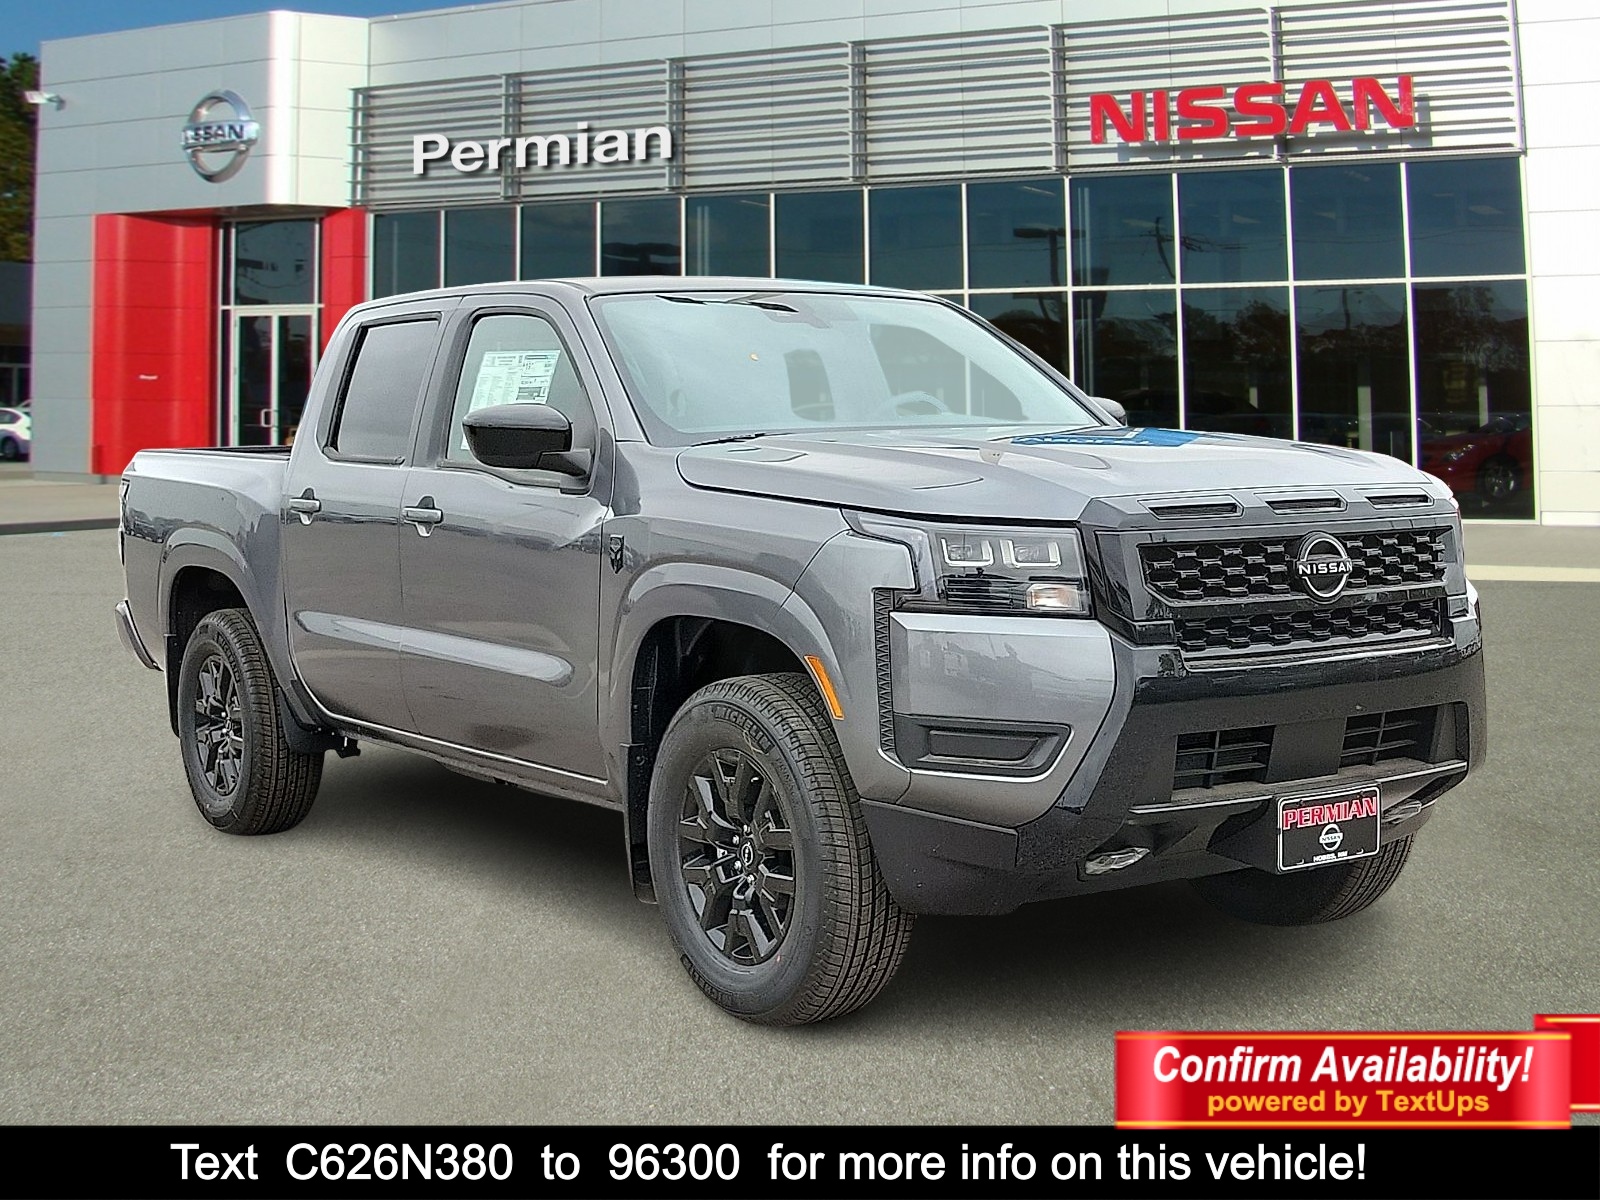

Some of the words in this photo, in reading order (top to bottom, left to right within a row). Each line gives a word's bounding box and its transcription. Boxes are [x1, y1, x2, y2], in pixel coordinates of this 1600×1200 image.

[1090, 75, 1414, 144] NISSAN
[182, 124, 244, 143] SSAN
[413, 121, 673, 175] Permian
[1298, 561, 1353, 575] NISSAN
[1283, 797, 1377, 830] PERMIAN
